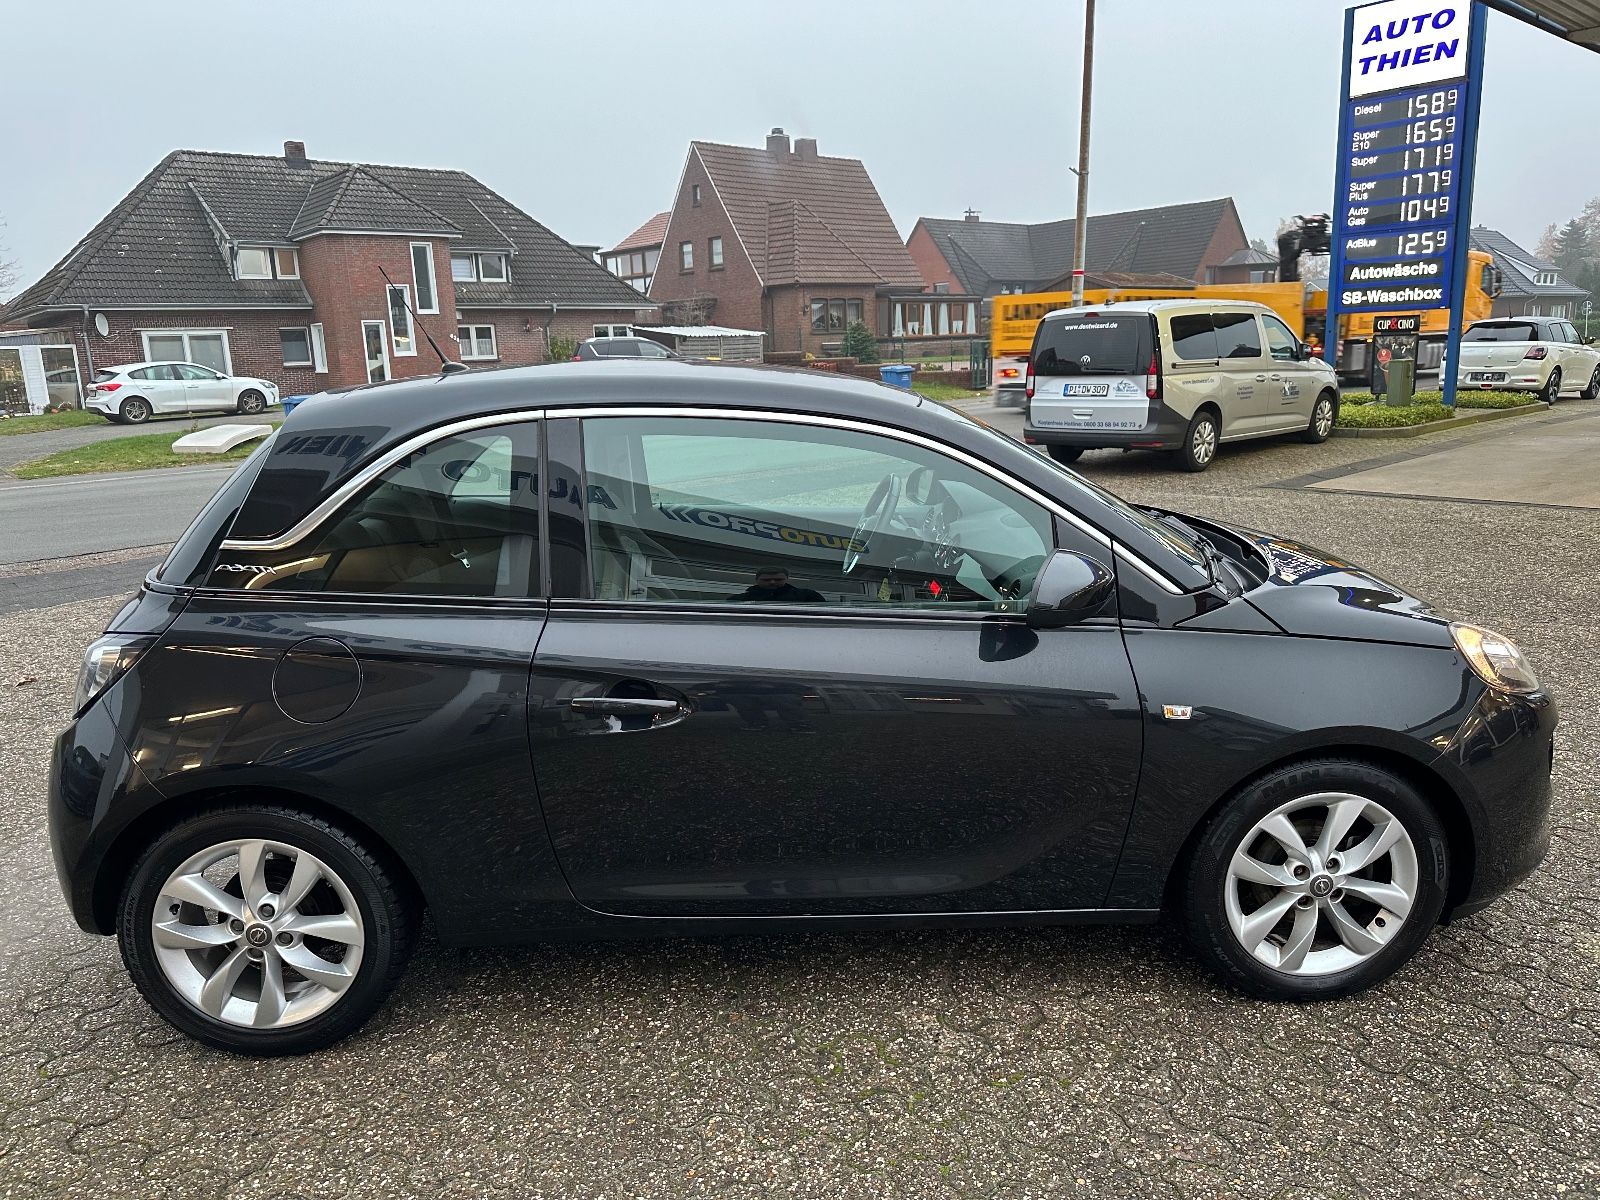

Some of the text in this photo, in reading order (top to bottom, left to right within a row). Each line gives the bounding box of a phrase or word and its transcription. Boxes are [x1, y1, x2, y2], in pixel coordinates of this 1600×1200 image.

[1361, 8, 1456, 46] AUTO
[1358, 38, 1460, 76] THIEN
[1354, 103, 1382, 116] Diesel
[1352, 129, 1380, 142] Super
[1352, 141, 1370, 152] E10
[1351, 155, 1379, 167] Super
[1349, 180, 1377, 193] Super
[1348, 192, 1369, 202] Plus
[1347, 206, 1369, 217] Auto
[1347, 216, 1366, 227] Gas
[1345, 238, 1377, 249] AdBlue
[1349, 261, 1438, 281] Autowäsche
[1341, 286, 1443, 306] SB-Waschbox
[1064, 322, 1118, 331] www.dentwizard.de
[1092, 385, 1106, 394] 309
